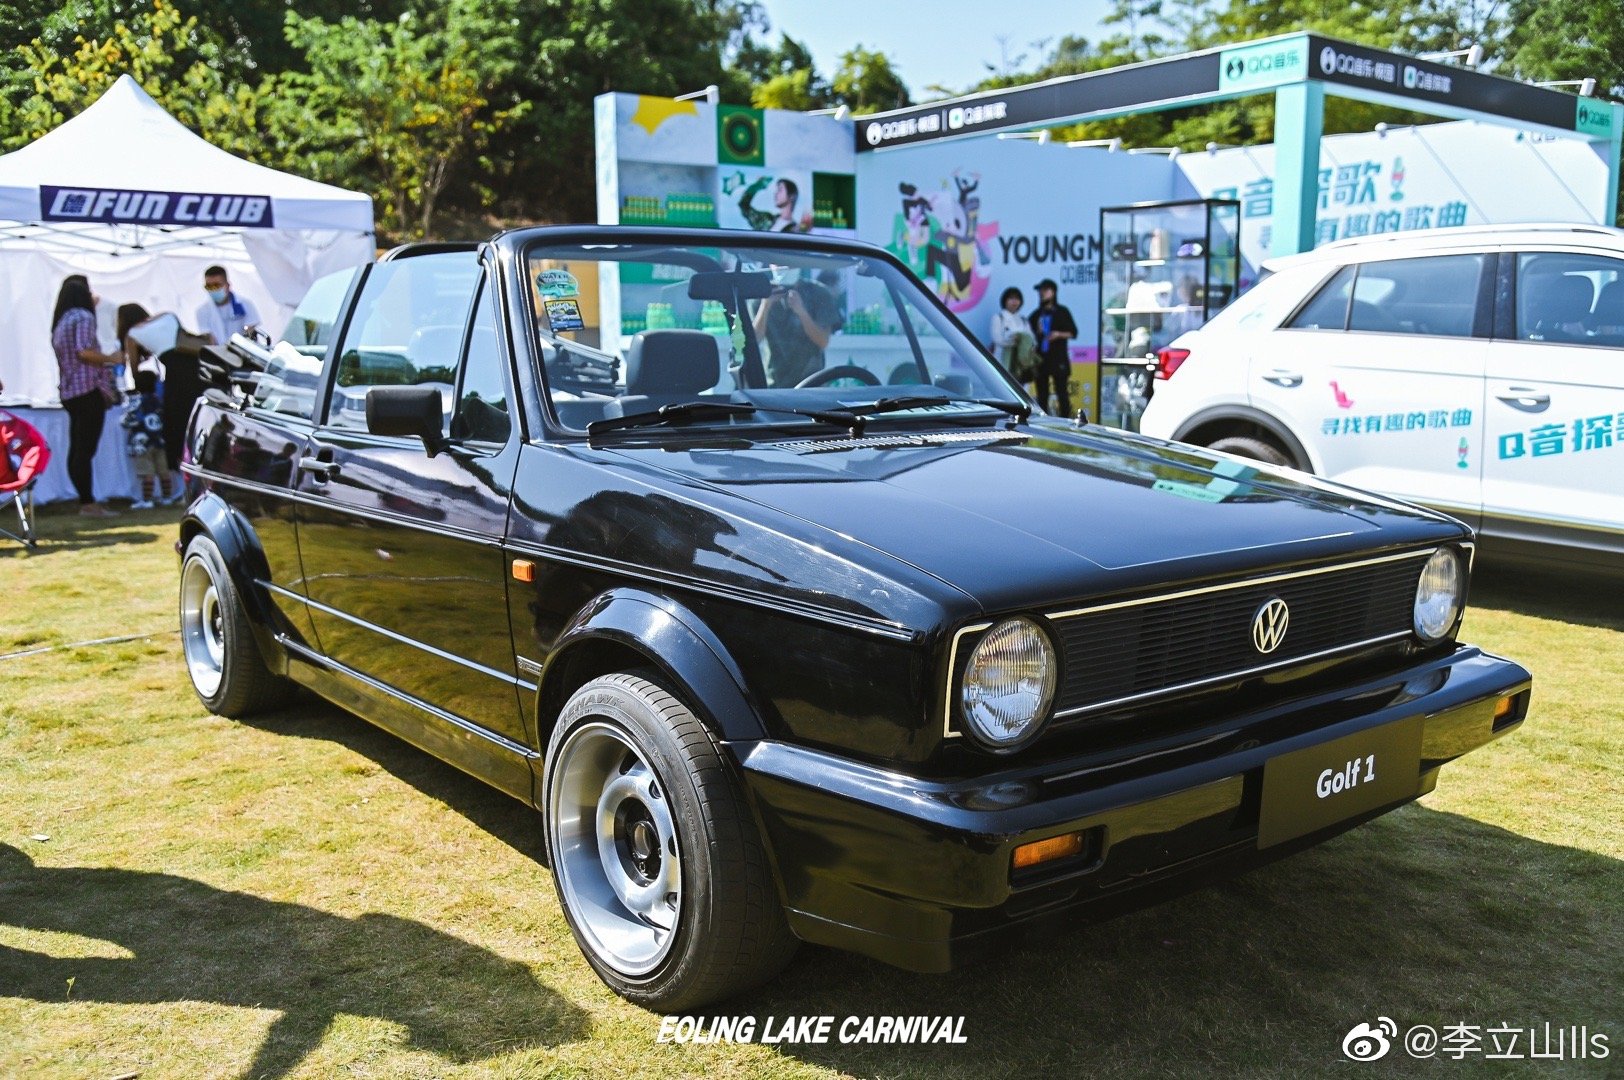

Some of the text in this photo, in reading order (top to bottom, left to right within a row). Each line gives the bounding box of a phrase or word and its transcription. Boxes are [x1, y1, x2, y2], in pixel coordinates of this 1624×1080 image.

[173, 195, 268, 223] CLUB
[1321, 408, 1472, 435] 寻找有趣的歌曲
[1498, 412, 1624, 460] Q音探
[1316, 754, 1375, 799] Golf 1
